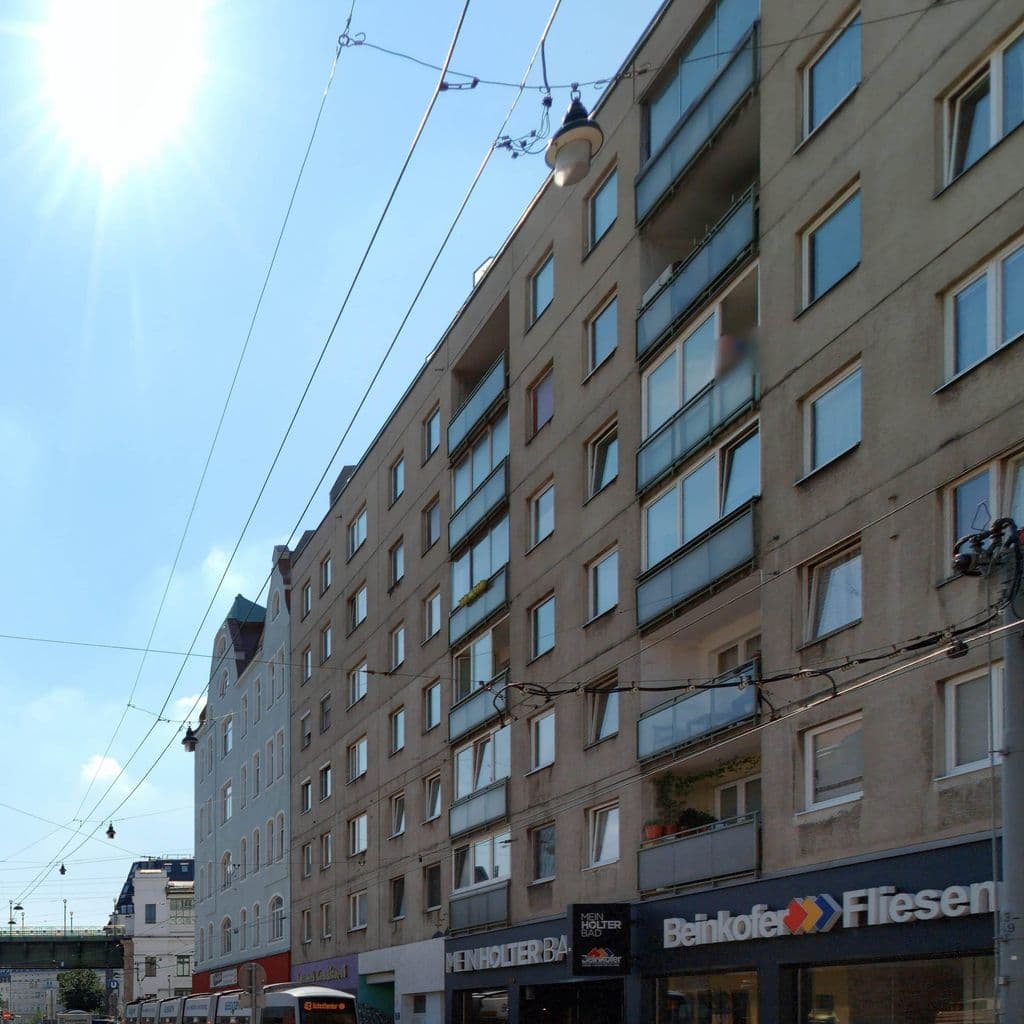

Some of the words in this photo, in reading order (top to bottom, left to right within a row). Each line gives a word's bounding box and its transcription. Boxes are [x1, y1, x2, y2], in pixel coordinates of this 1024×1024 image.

[581, 912, 604, 921] MEIN
[663, 904, 791, 949] Beinkofer
[842, 881, 1000, 928] Fliesen
[581, 920, 623, 930] HOLTER
[581, 929, 602, 937] BAD
[445, 949, 477, 973] MEIN
[478, 938, 544, 969] HOLTER
[543, 934, 569, 963] BA
